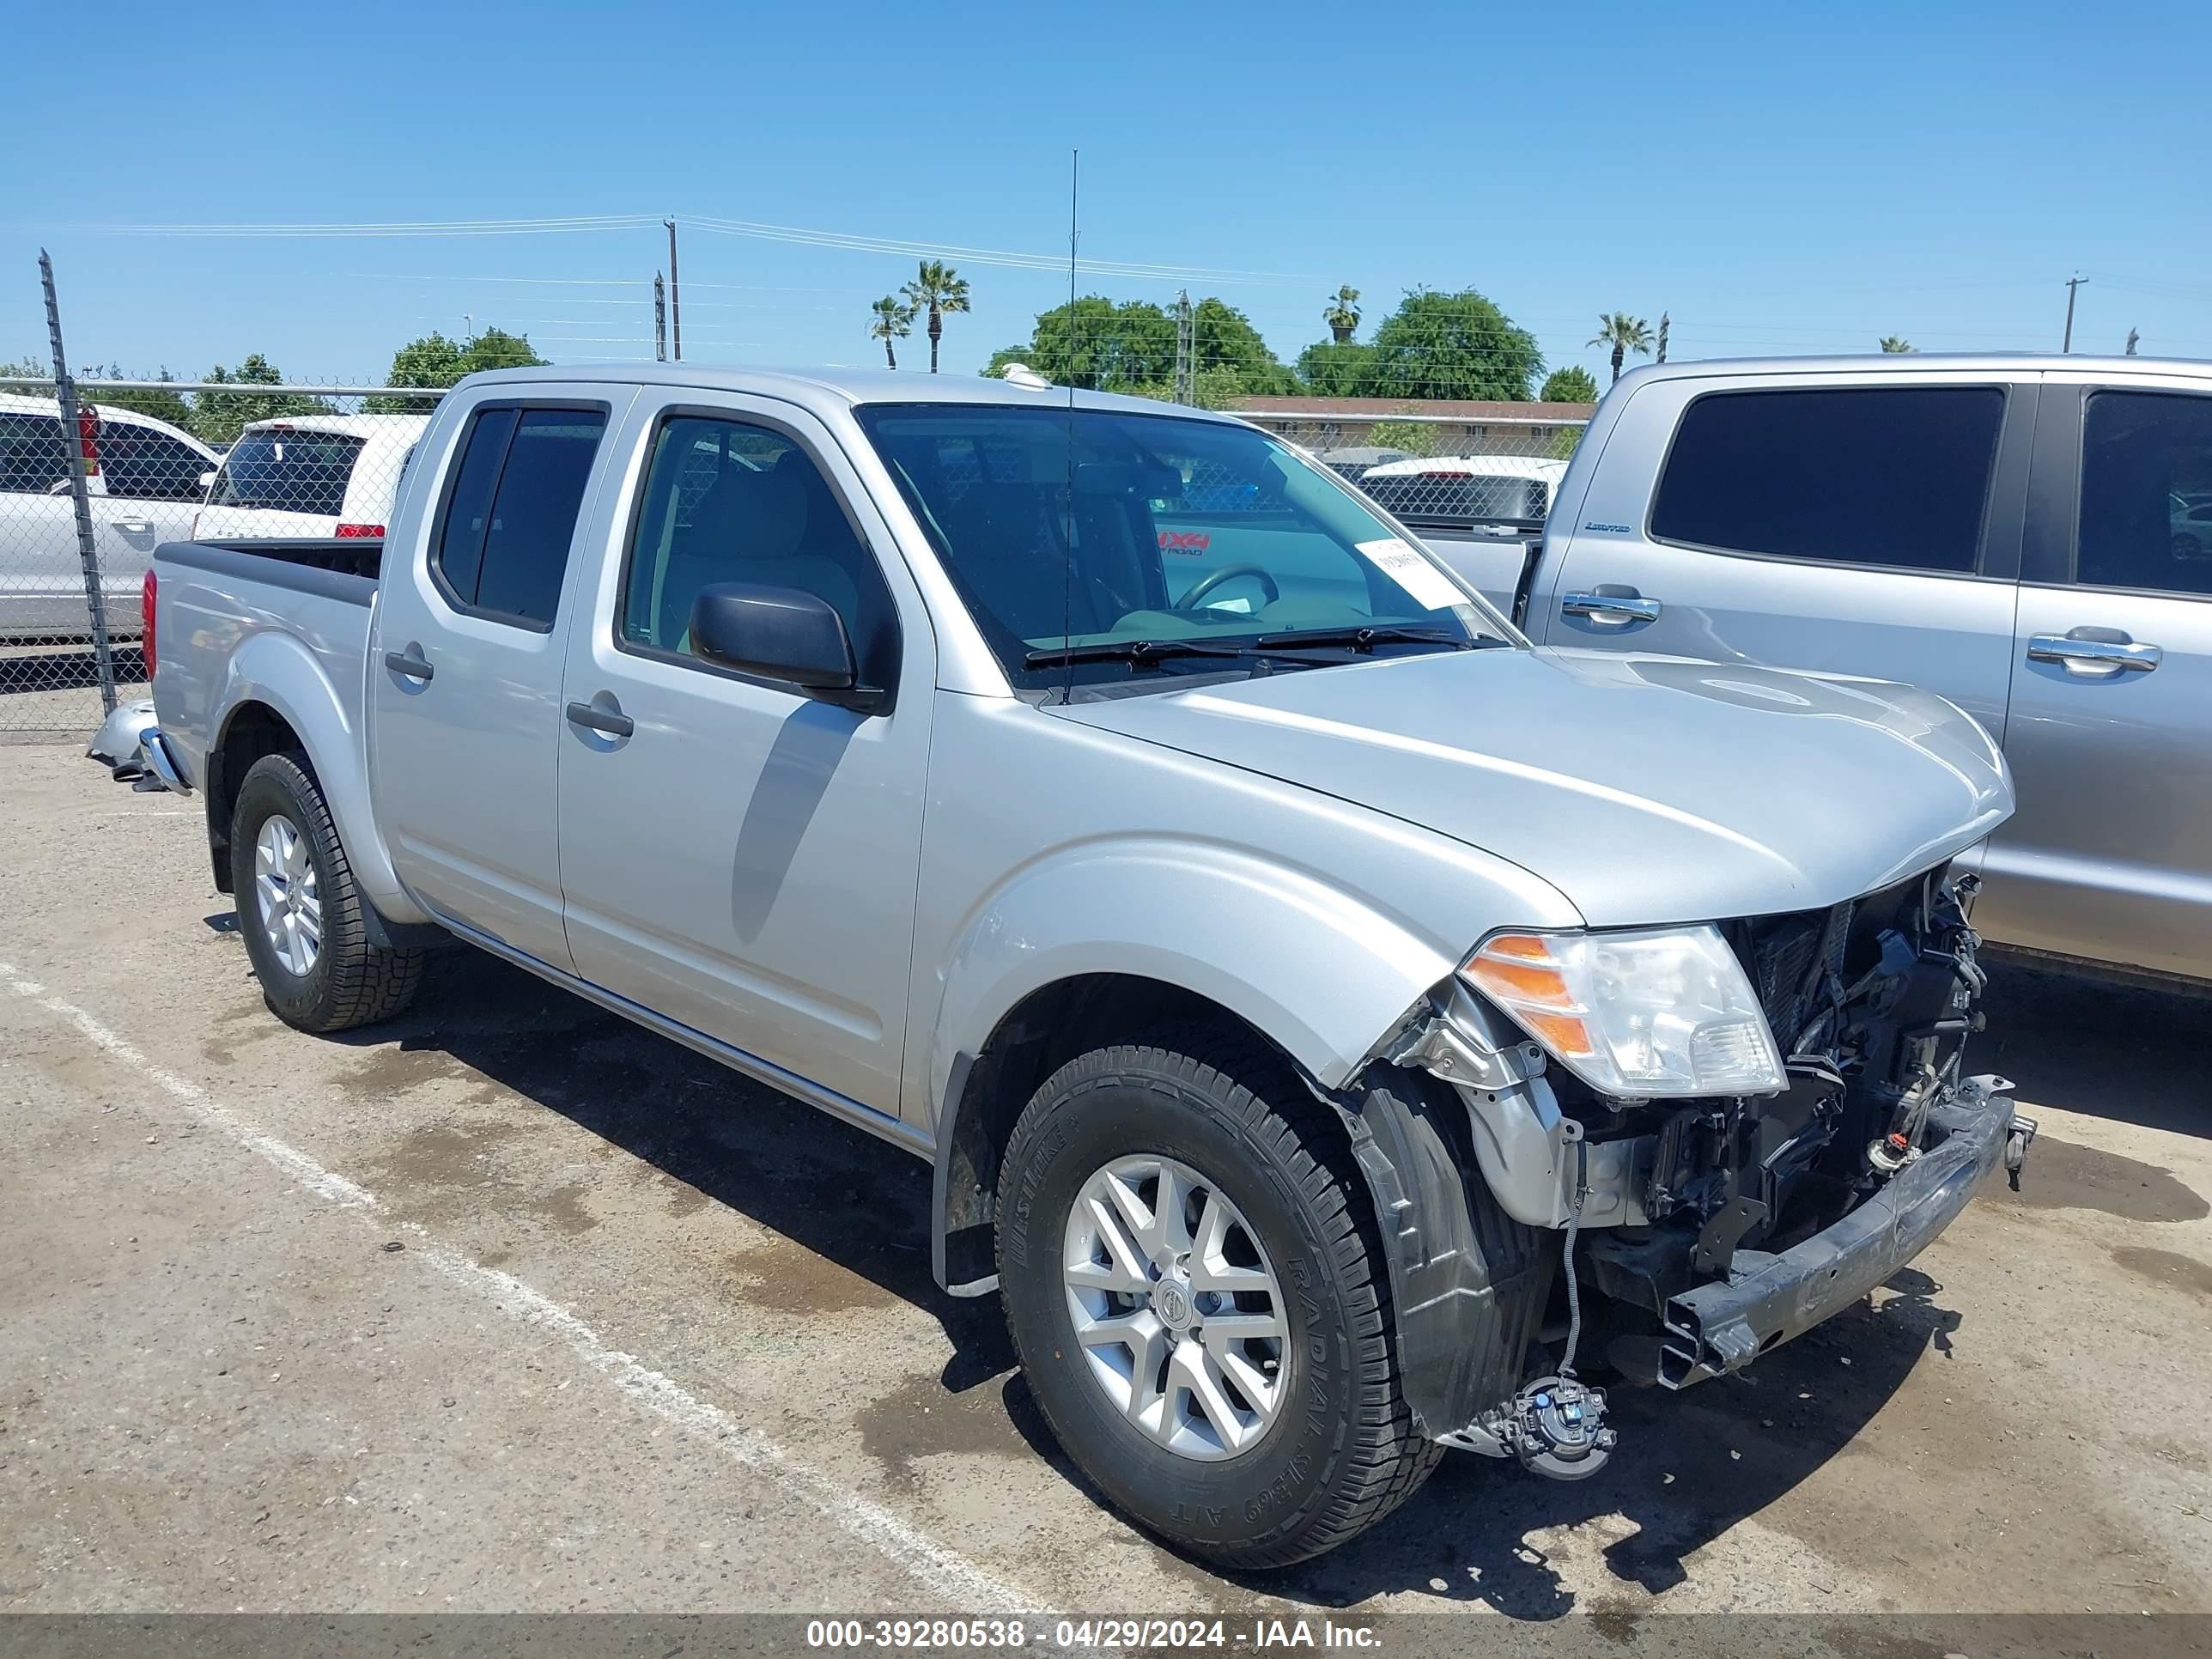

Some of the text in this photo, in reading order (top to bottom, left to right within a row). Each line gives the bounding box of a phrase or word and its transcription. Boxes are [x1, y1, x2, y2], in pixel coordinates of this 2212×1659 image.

[1009, 1123, 1066, 1270] WESTLAKE
[1288, 1257, 1329, 1437] RADIAL
[1245, 1443, 1312, 1524] SL369
